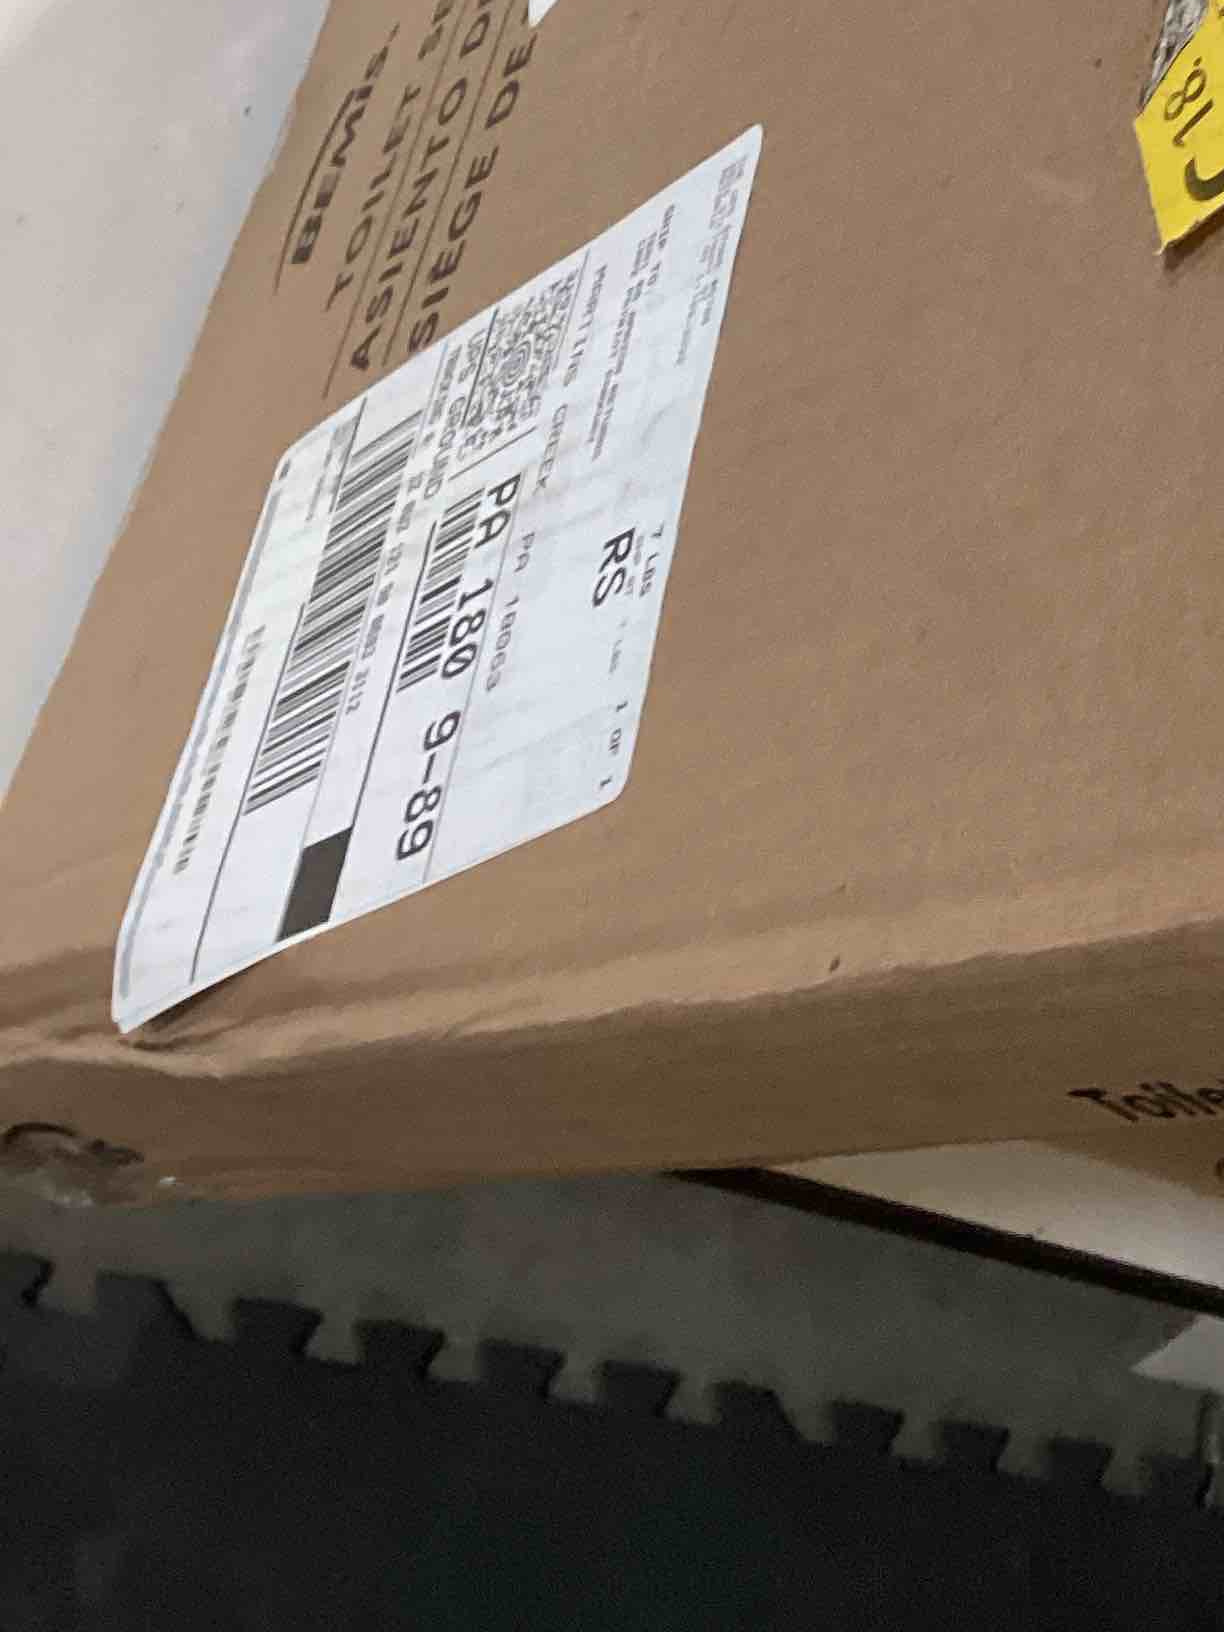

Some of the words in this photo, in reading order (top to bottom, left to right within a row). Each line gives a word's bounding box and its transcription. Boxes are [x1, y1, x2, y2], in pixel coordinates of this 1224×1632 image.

[485, 33, 538, 129] DE
[325, 84, 421, 311] TOILET
[350, 76, 467, 370] ASIENTO
[420, 390, 468, 505] GROUND
[472, 470, 522, 553] PA
[588, 523, 638, 613] RS
[436, 571, 497, 687] 180
[390, 705, 463, 867] 9-89
